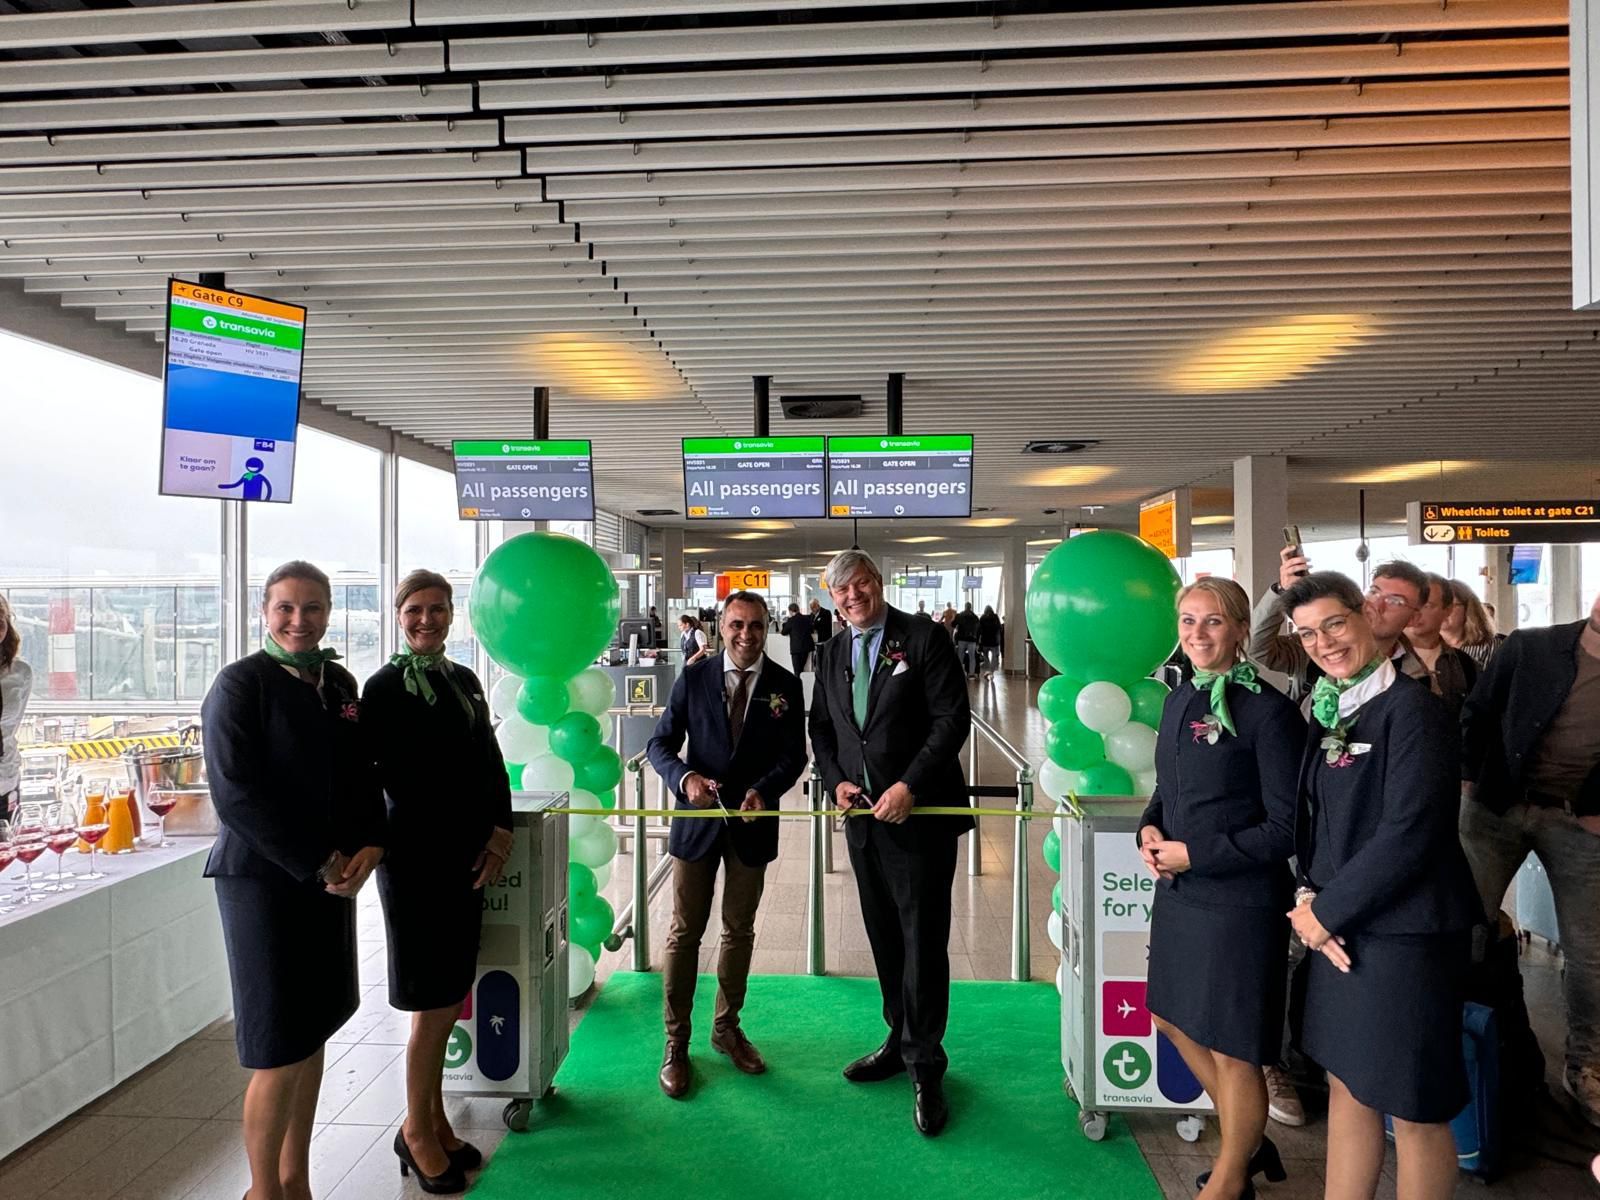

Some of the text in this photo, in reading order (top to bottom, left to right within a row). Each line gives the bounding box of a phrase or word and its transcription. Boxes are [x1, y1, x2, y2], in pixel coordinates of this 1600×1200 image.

[192, 288, 224, 304] Gate
[228, 296, 244, 308] C9
[219, 319, 276, 338] transavia
[188, 346, 222, 357] Gate open
[180, 455, 203, 464] Klaar
[754, 461, 770, 469] OPEN
[190, 464, 216, 472] gaan?
[462, 482, 588, 502] All passengers
[690, 480, 820, 500] All passengers
[833, 479, 966, 499] All passengers
[1440, 506, 1594, 517] Wheelchair toilet at gate C21
[1475, 528, 1510, 537] Toilets
[743, 574, 767, 587] C11
[1103, 872, 1158, 891] Sele
[1103, 897, 1137, 917] for
[1103, 1093, 1153, 1104] transavia
